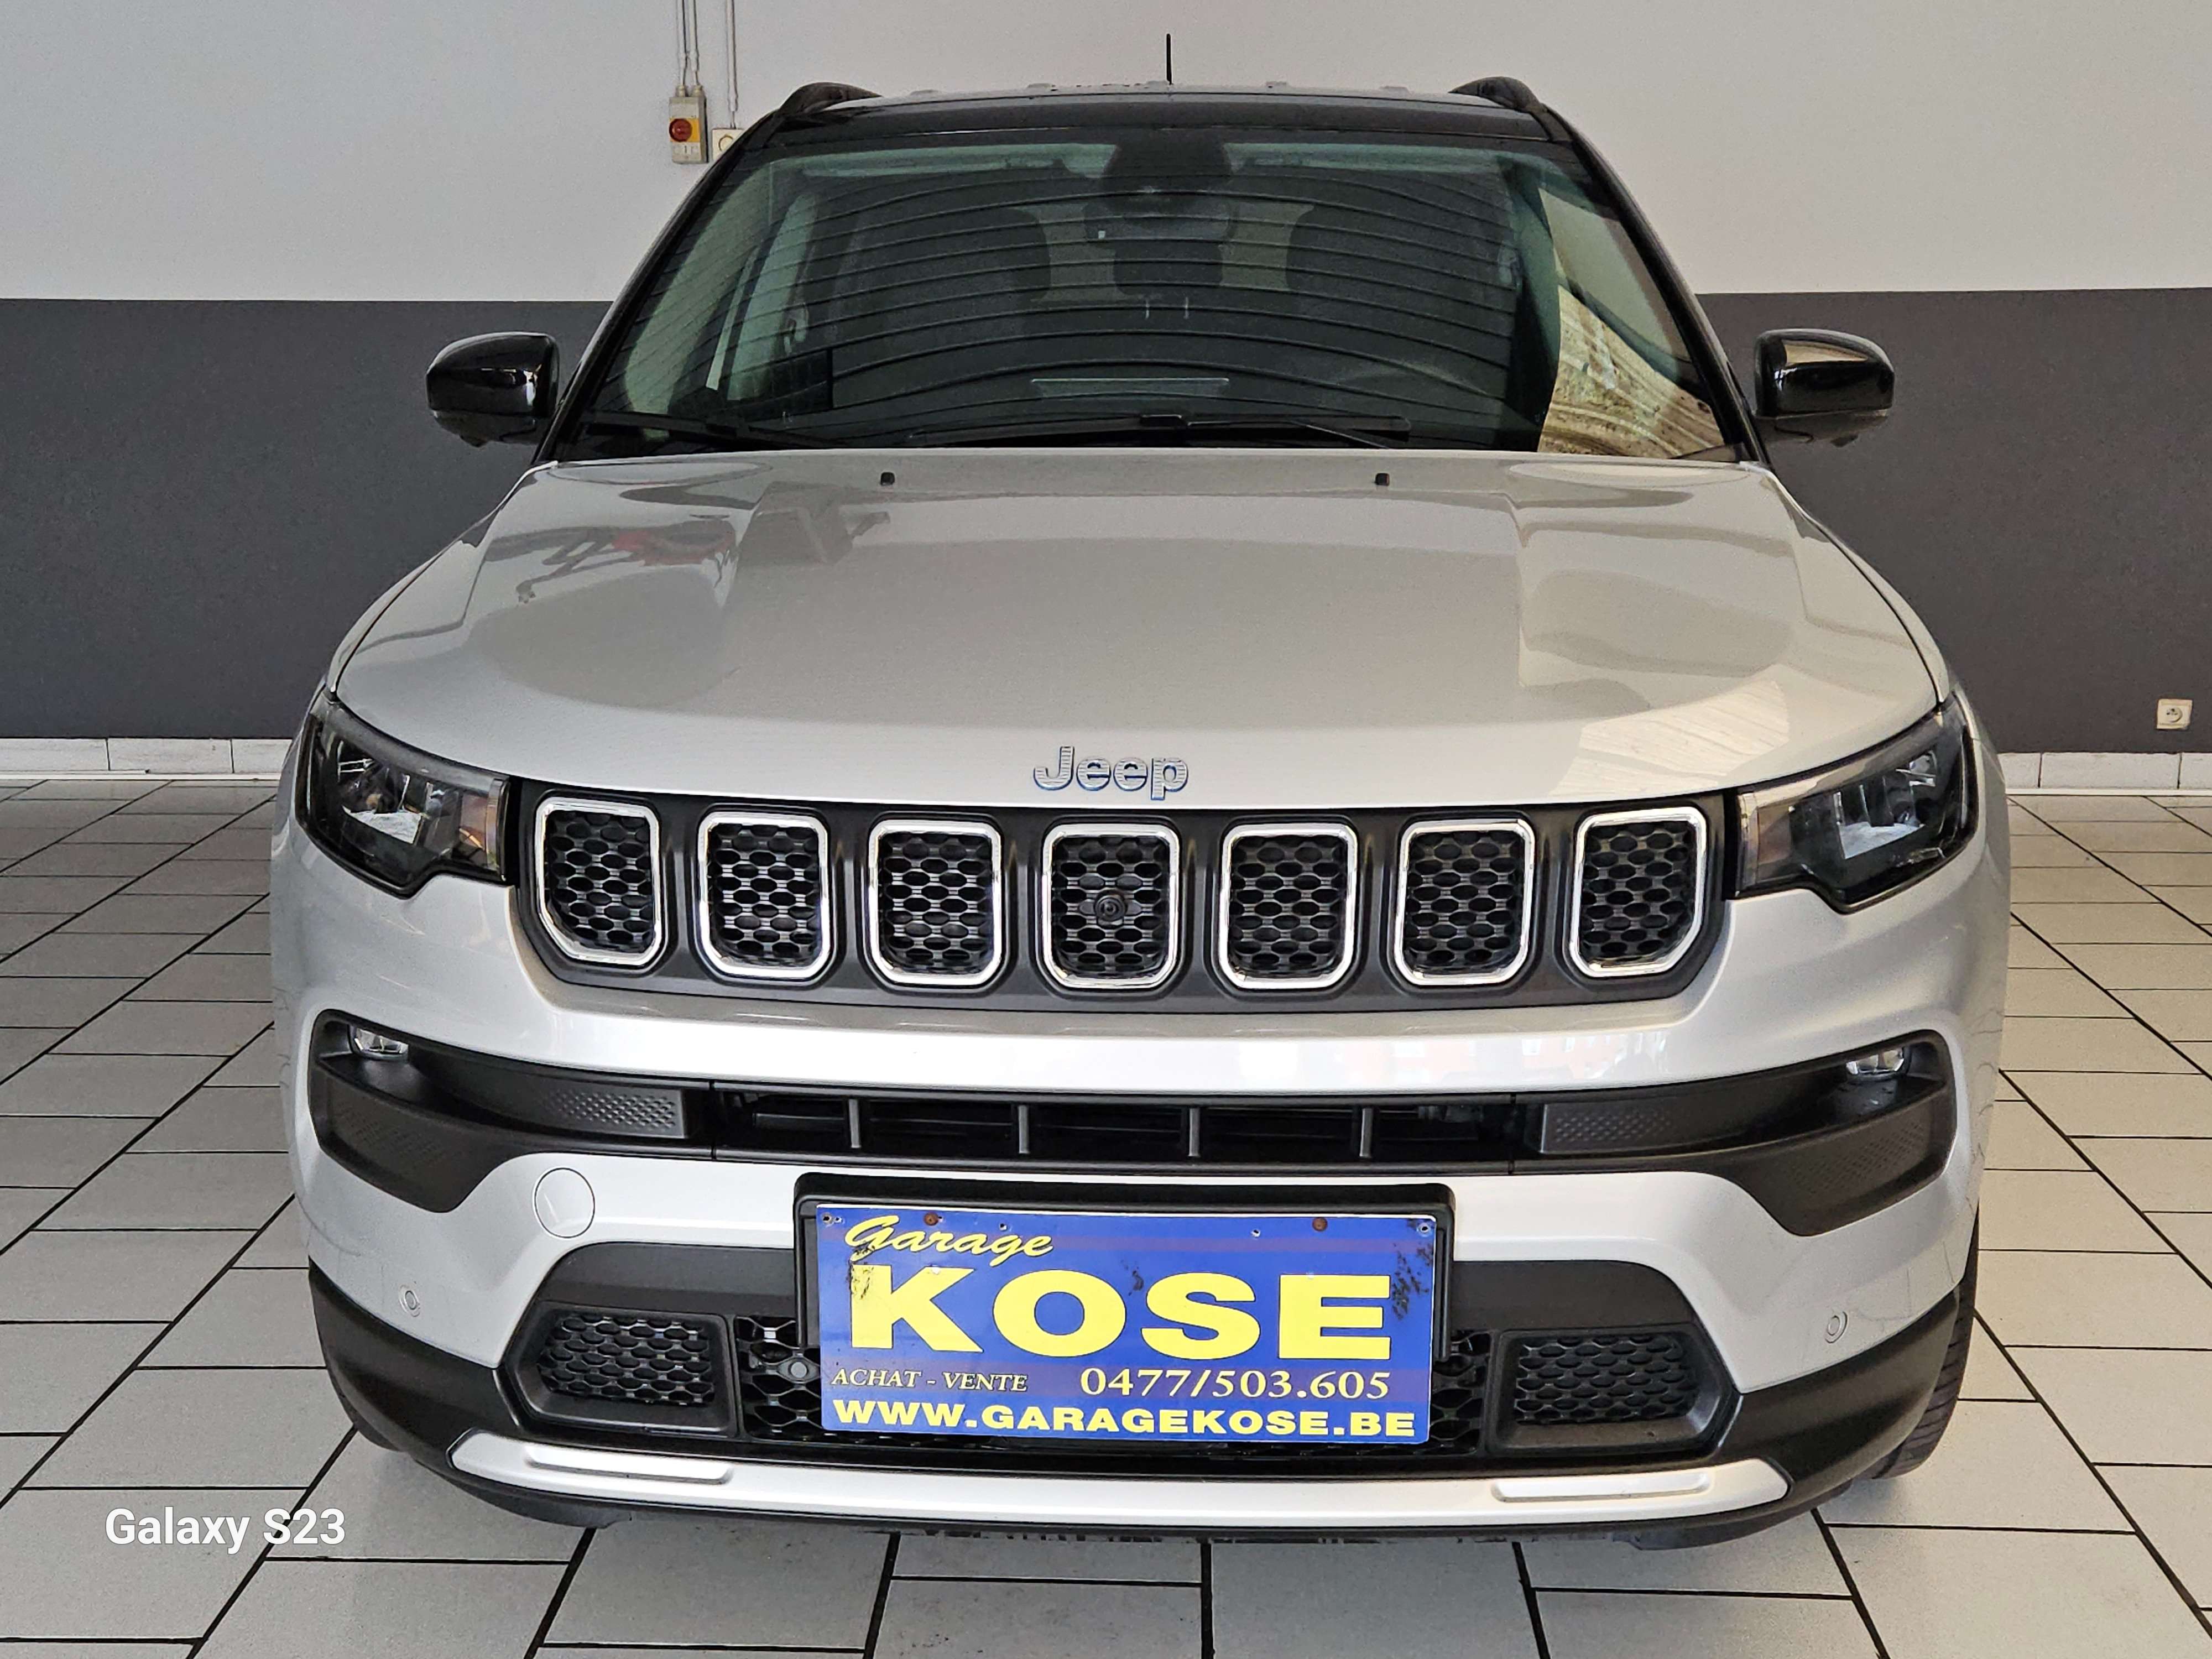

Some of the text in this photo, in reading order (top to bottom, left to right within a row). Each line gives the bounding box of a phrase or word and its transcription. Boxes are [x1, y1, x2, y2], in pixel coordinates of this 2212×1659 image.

[1033, 745, 1188, 801] Jeep
[845, 1215, 1053, 1267] Garage
[850, 1264, 1392, 1360] KOSE
[831, 1368, 922, 1388] ACHAT
[942, 1371, 1029, 1392] VENTE
[1080, 1367, 1391, 1400] 0477/503.605
[832, 1399, 1416, 1438] WWW.GARAGEKOSE.BE
